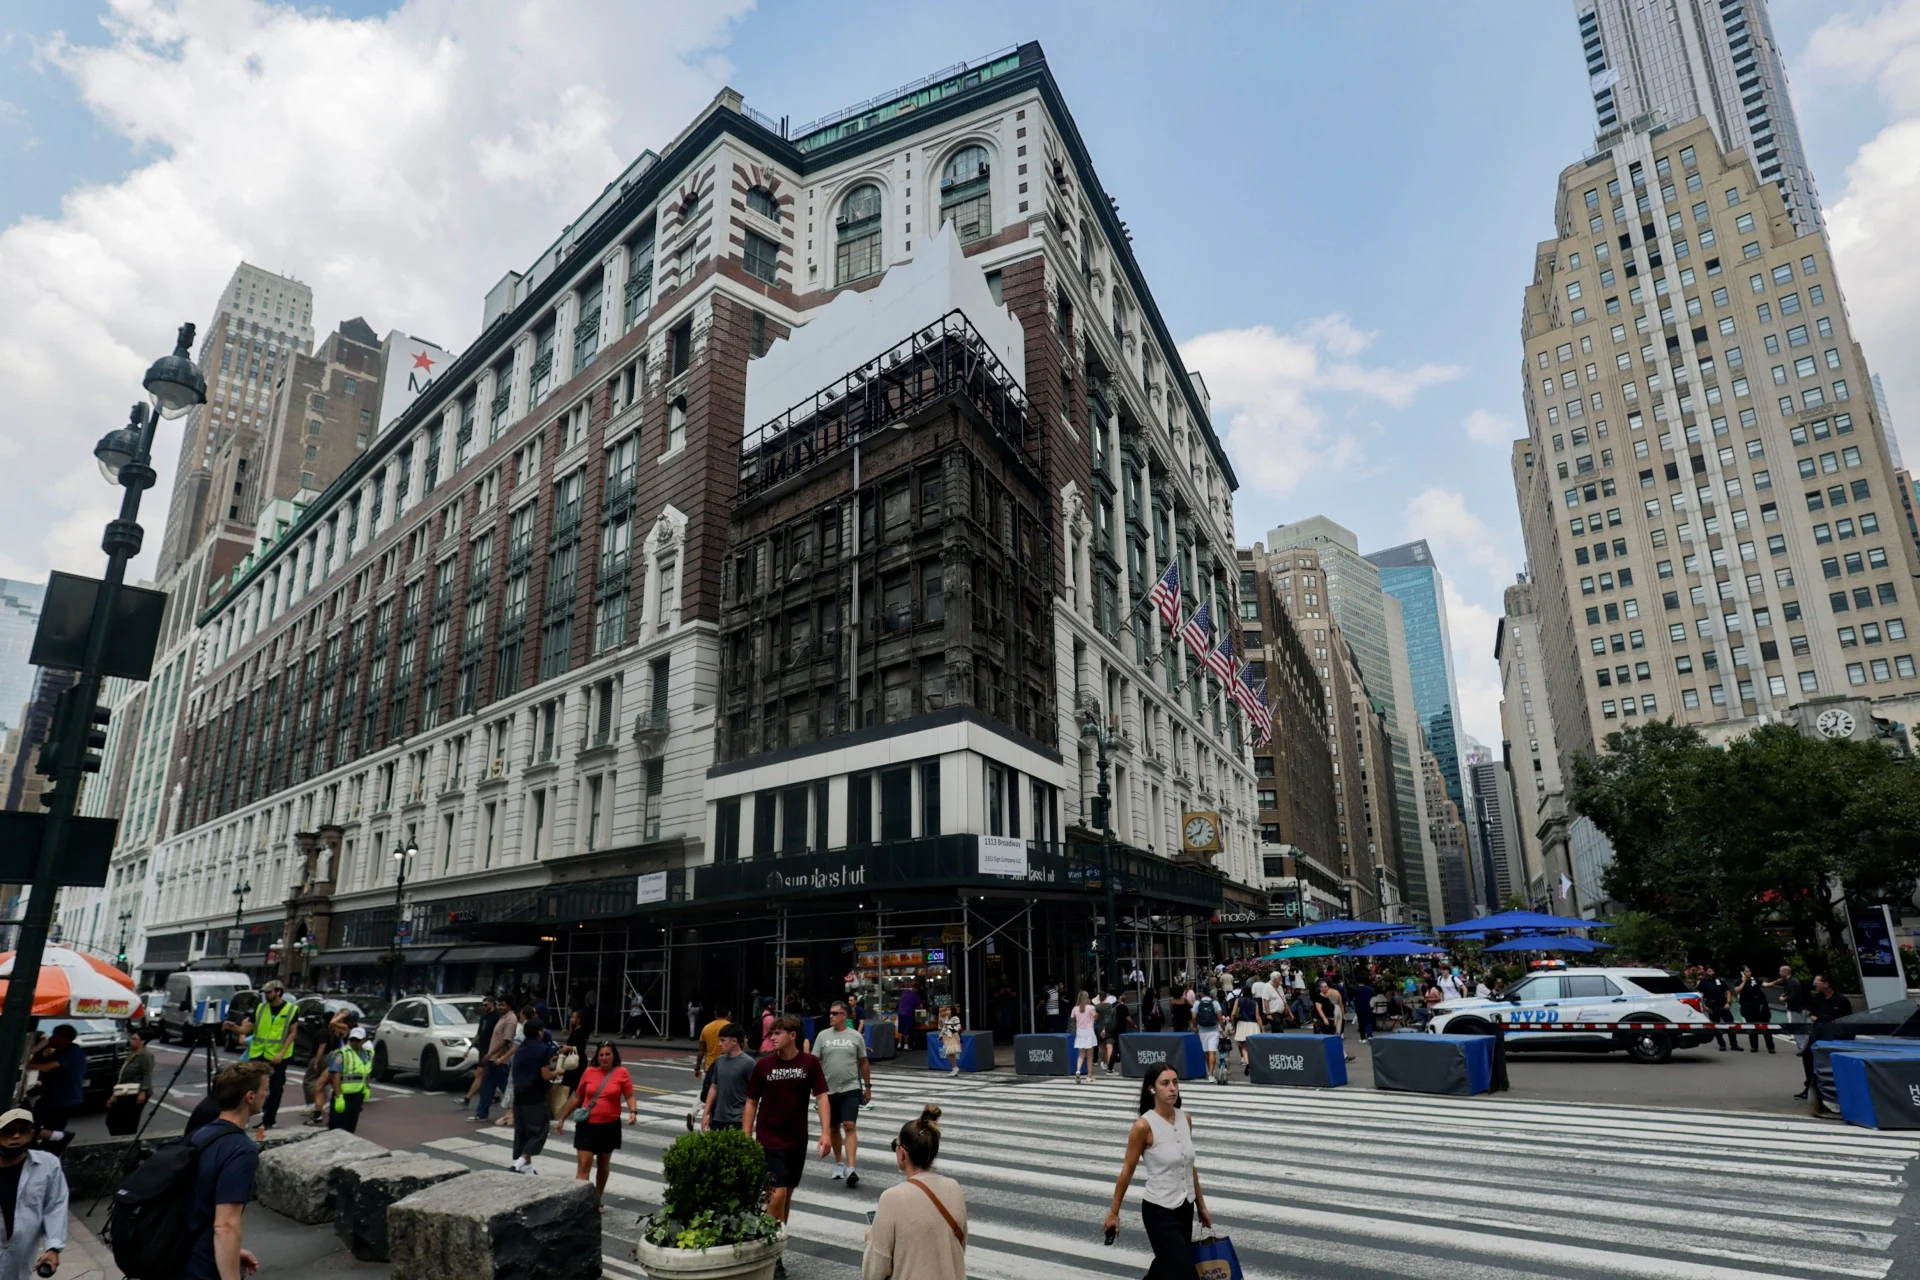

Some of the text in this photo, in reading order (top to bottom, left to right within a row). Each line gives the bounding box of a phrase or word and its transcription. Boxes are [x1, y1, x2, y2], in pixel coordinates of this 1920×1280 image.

[984, 838, 1021, 848] 1313 Broadway
[1067, 871, 1082, 879] West
[1093, 868, 1101, 877] St
[1219, 910, 1256, 924] macy's
[1510, 1010, 1559, 1023] NYPD
[1137, 1050, 1167, 1058] HERALD
[1268, 1054, 1304, 1063] HERALD
[1028, 1055, 1054, 1063] SQUARE
[1269, 1062, 1304, 1070] SQUARE
